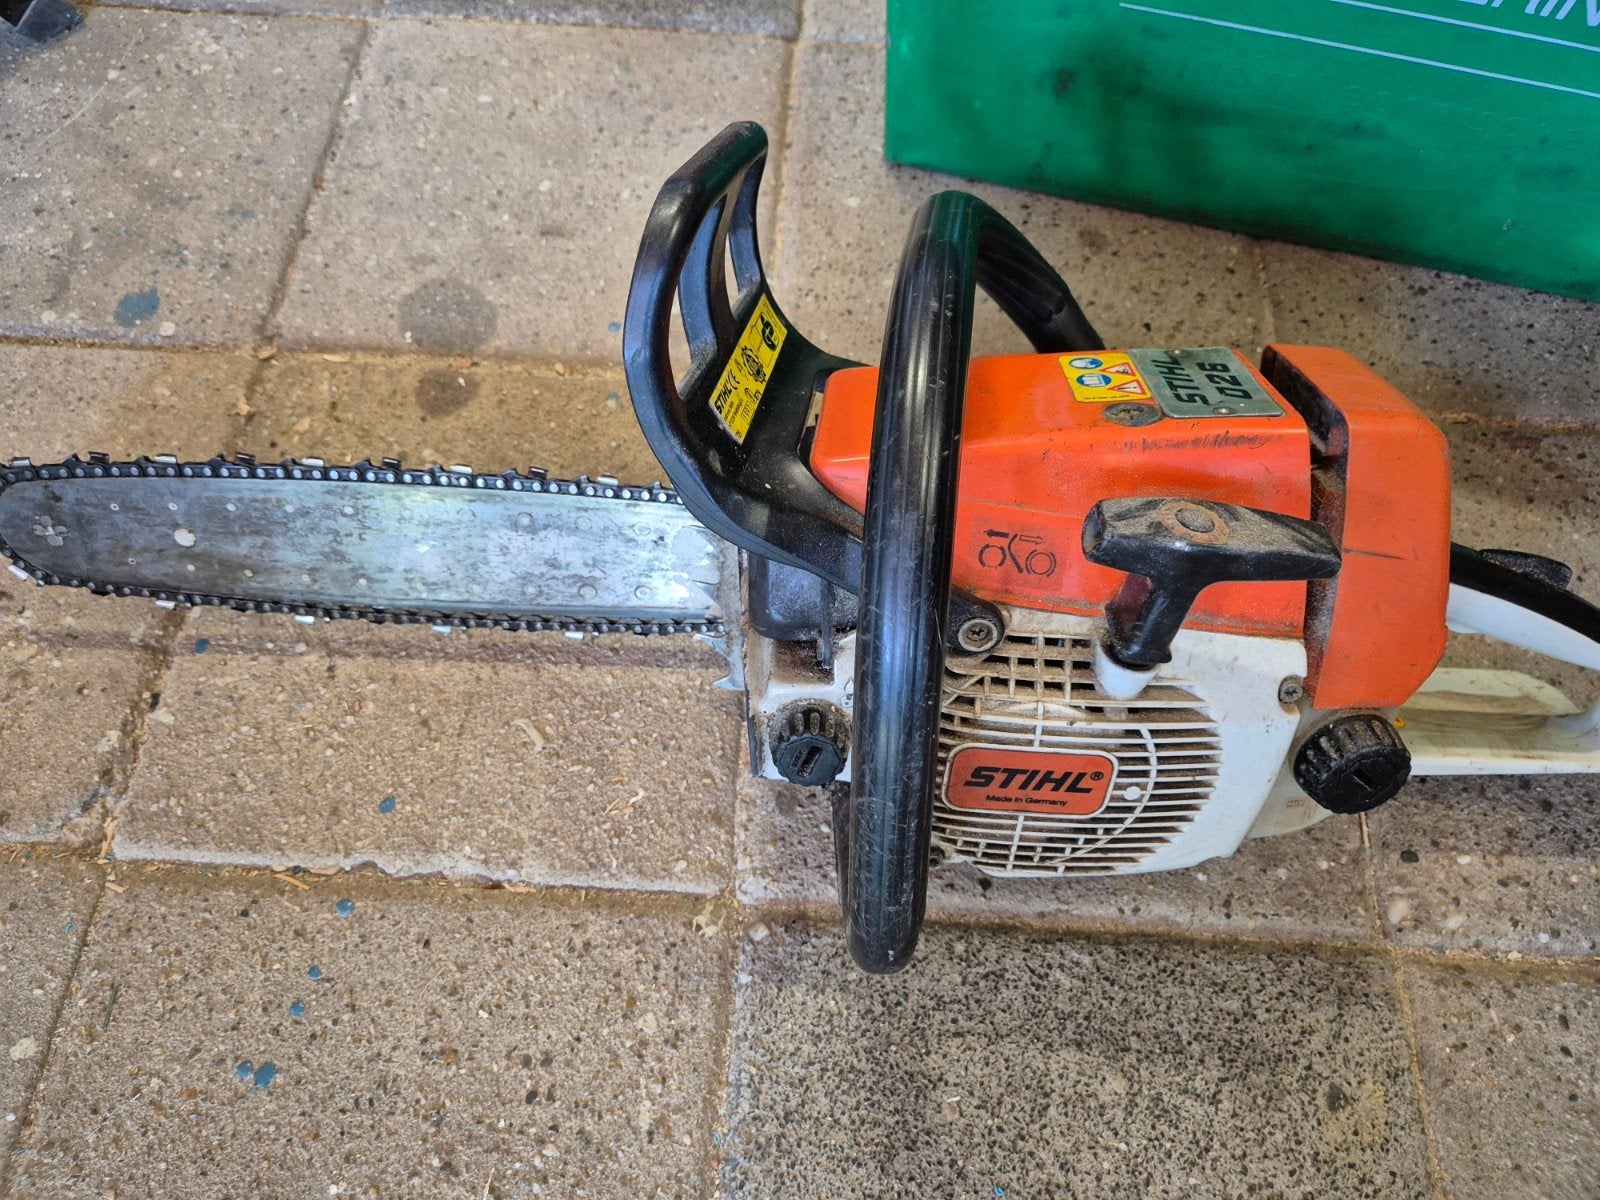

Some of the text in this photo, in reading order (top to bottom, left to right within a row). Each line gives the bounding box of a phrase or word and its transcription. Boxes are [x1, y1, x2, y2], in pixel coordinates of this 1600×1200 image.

[714, 379, 733, 414] STIHL
[1152, 357, 1211, 406] STIHL
[1196, 362, 1254, 400] 026
[985, 794, 1012, 804] Made
[1025, 796, 1068, 807] Germany
